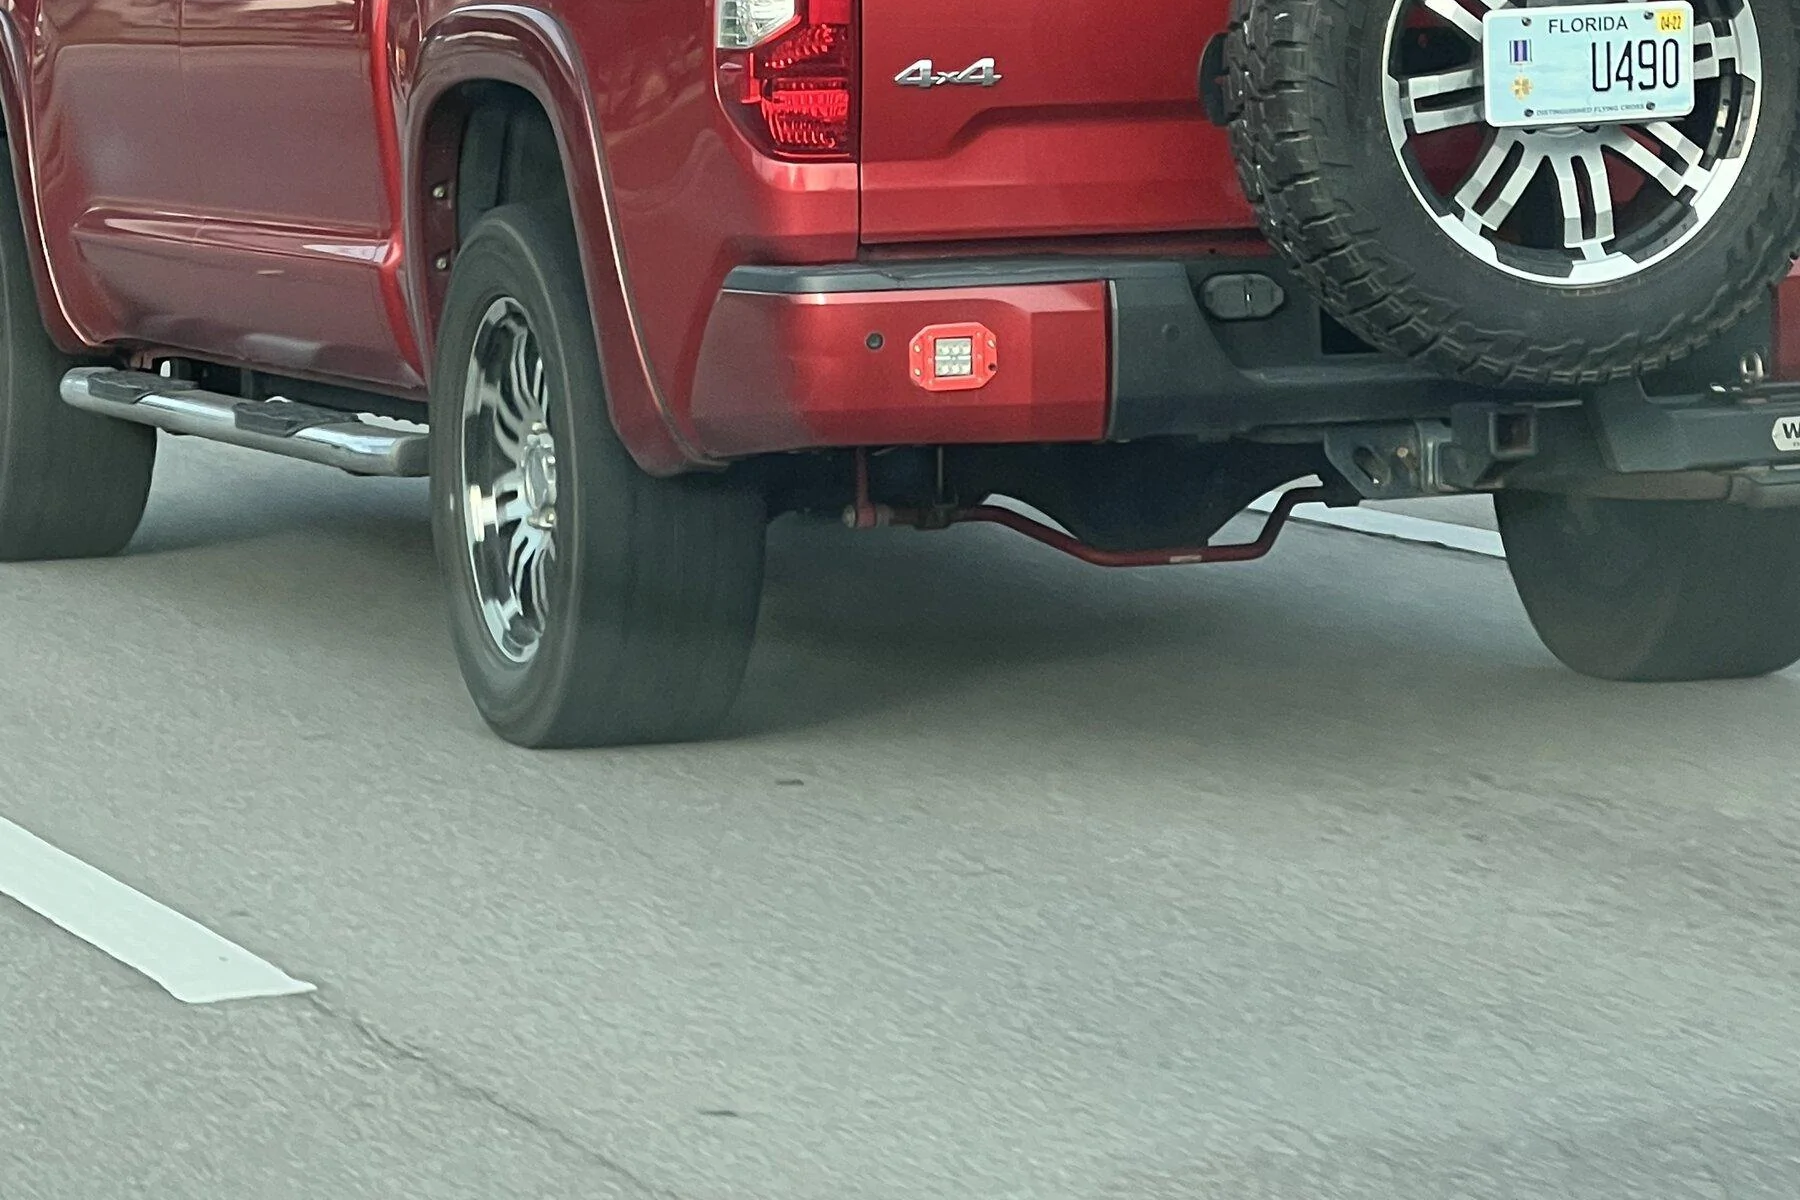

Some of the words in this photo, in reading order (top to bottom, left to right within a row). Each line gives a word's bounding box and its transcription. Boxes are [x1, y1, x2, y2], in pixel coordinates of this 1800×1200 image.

[1548, 16, 1629, 34] FLORIDA
[894, 57, 1003, 87] 4x4
[1591, 38, 1680, 92] U490
